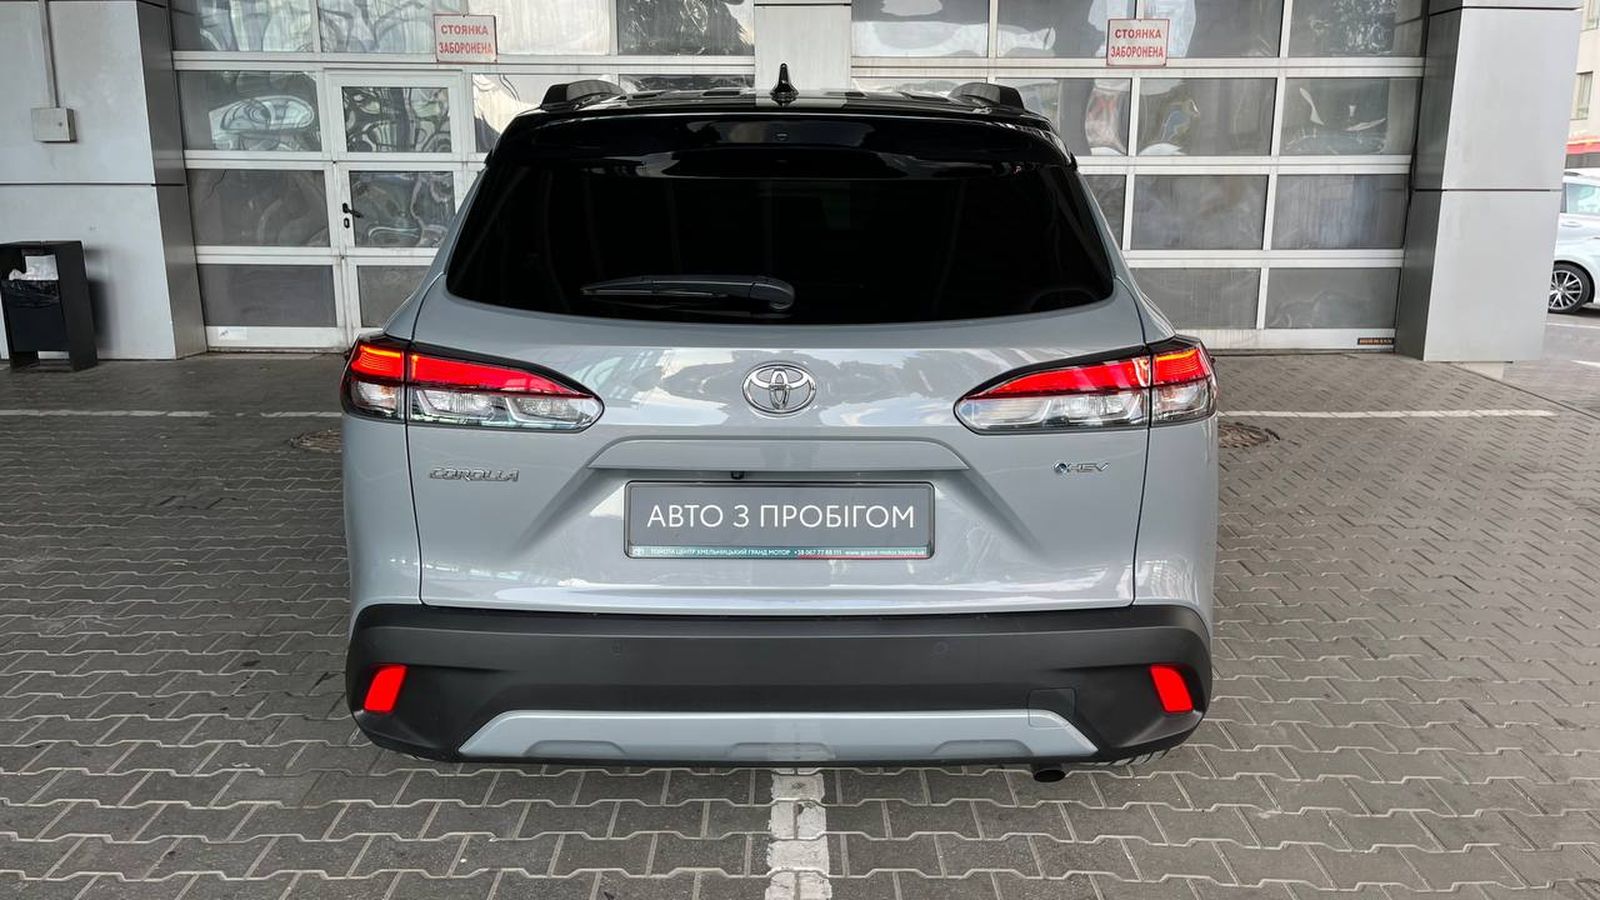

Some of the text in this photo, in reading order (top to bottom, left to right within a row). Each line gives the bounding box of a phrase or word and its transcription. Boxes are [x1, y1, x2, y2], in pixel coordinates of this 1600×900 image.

[440, 24, 489, 36] СТОЯНКА
[1114, 28, 1162, 39] СТОЯНКА
[439, 41, 494, 55] ЗАБОРОНЕНА
[1110, 45, 1164, 58] ЗАБОРОНЕНА
[429, 467, 520, 482] COROLLA
[646, 504, 724, 529] АВТО
[760, 504, 915, 529] ПРОБІГОМ
